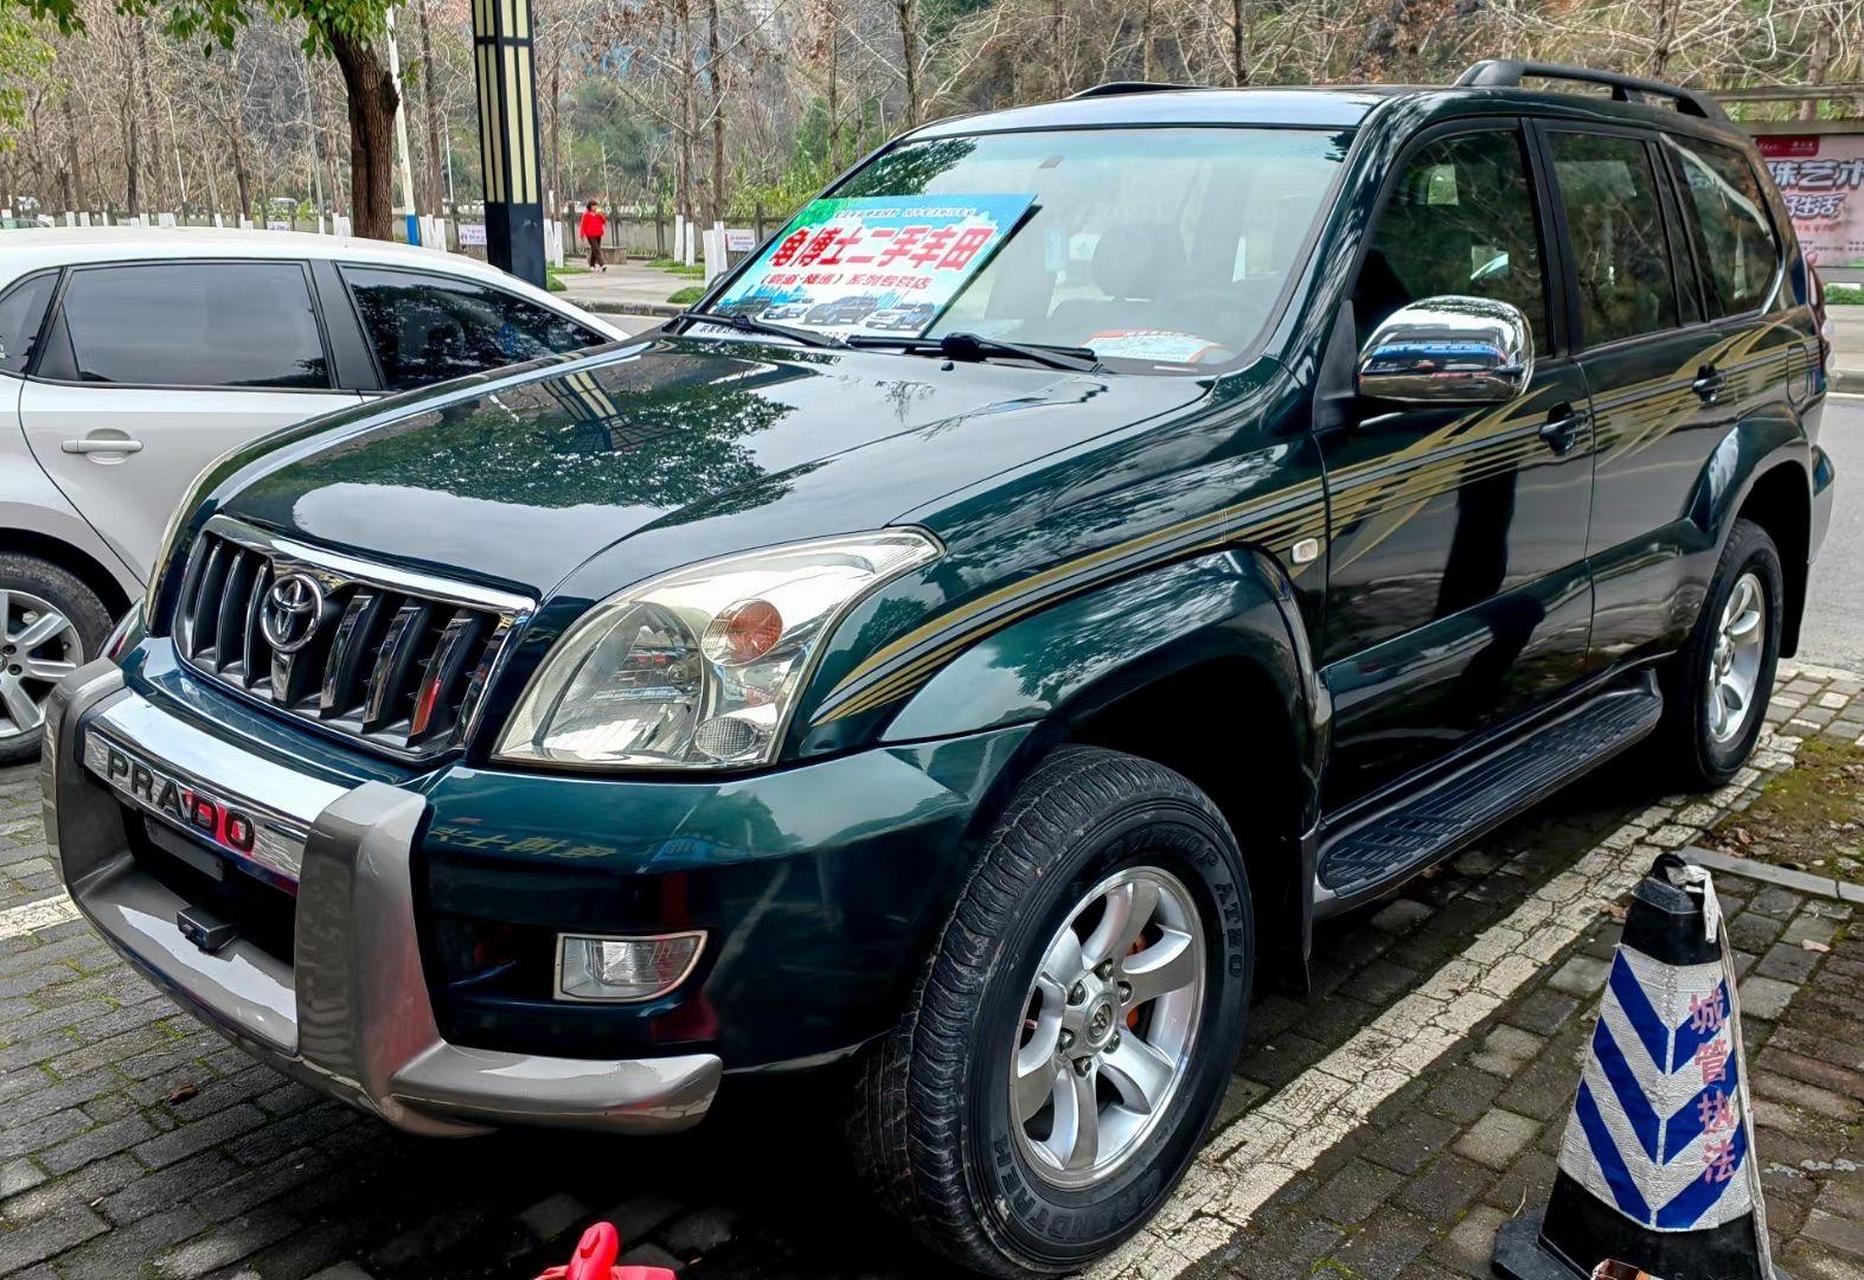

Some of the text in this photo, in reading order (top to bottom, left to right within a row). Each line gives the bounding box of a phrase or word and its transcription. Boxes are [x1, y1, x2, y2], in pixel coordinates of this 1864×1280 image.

[107, 747, 256, 852] PRADO
[1689, 988, 1735, 1184] 城管执法
